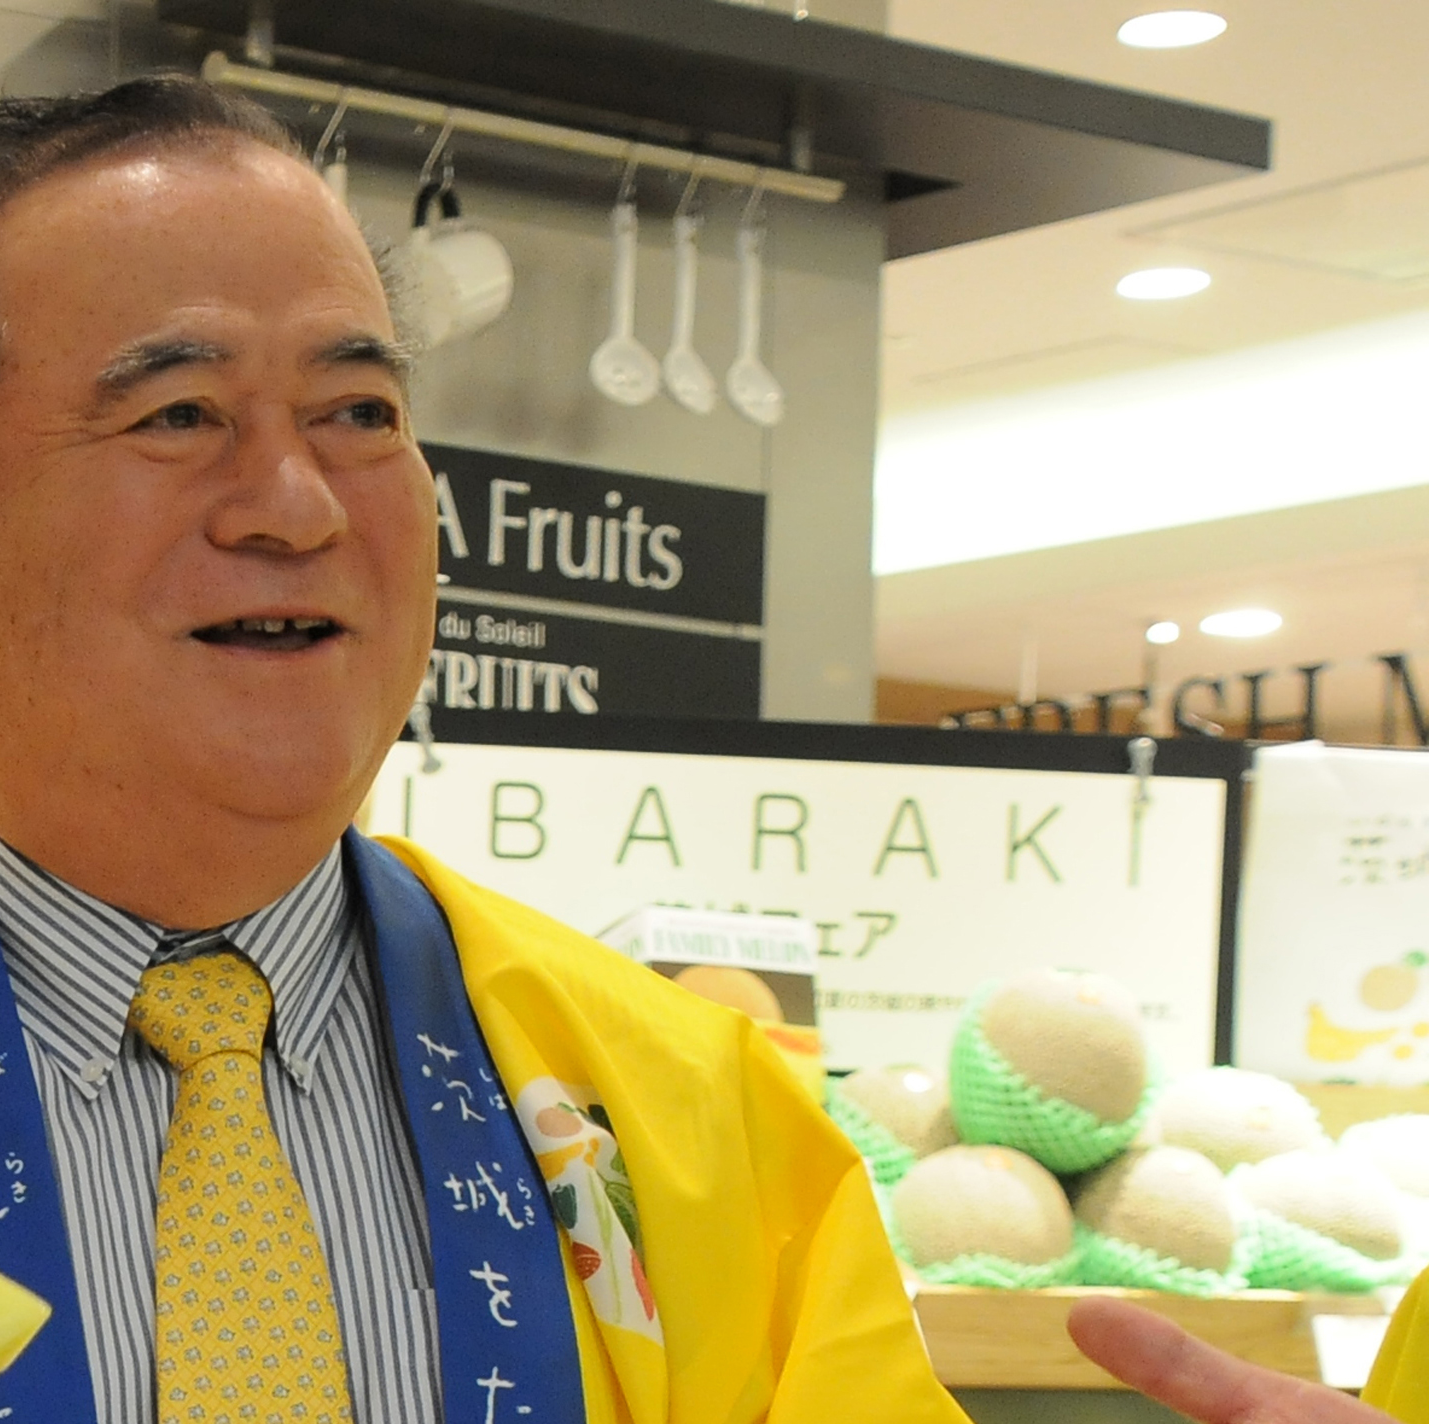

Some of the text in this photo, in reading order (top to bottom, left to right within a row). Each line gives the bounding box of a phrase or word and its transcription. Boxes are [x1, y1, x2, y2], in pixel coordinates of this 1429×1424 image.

[487, 478, 684, 590] Fruits
[439, 611, 547, 649] du Soleil
[403, 776, 1149, 888] IBARAKI
